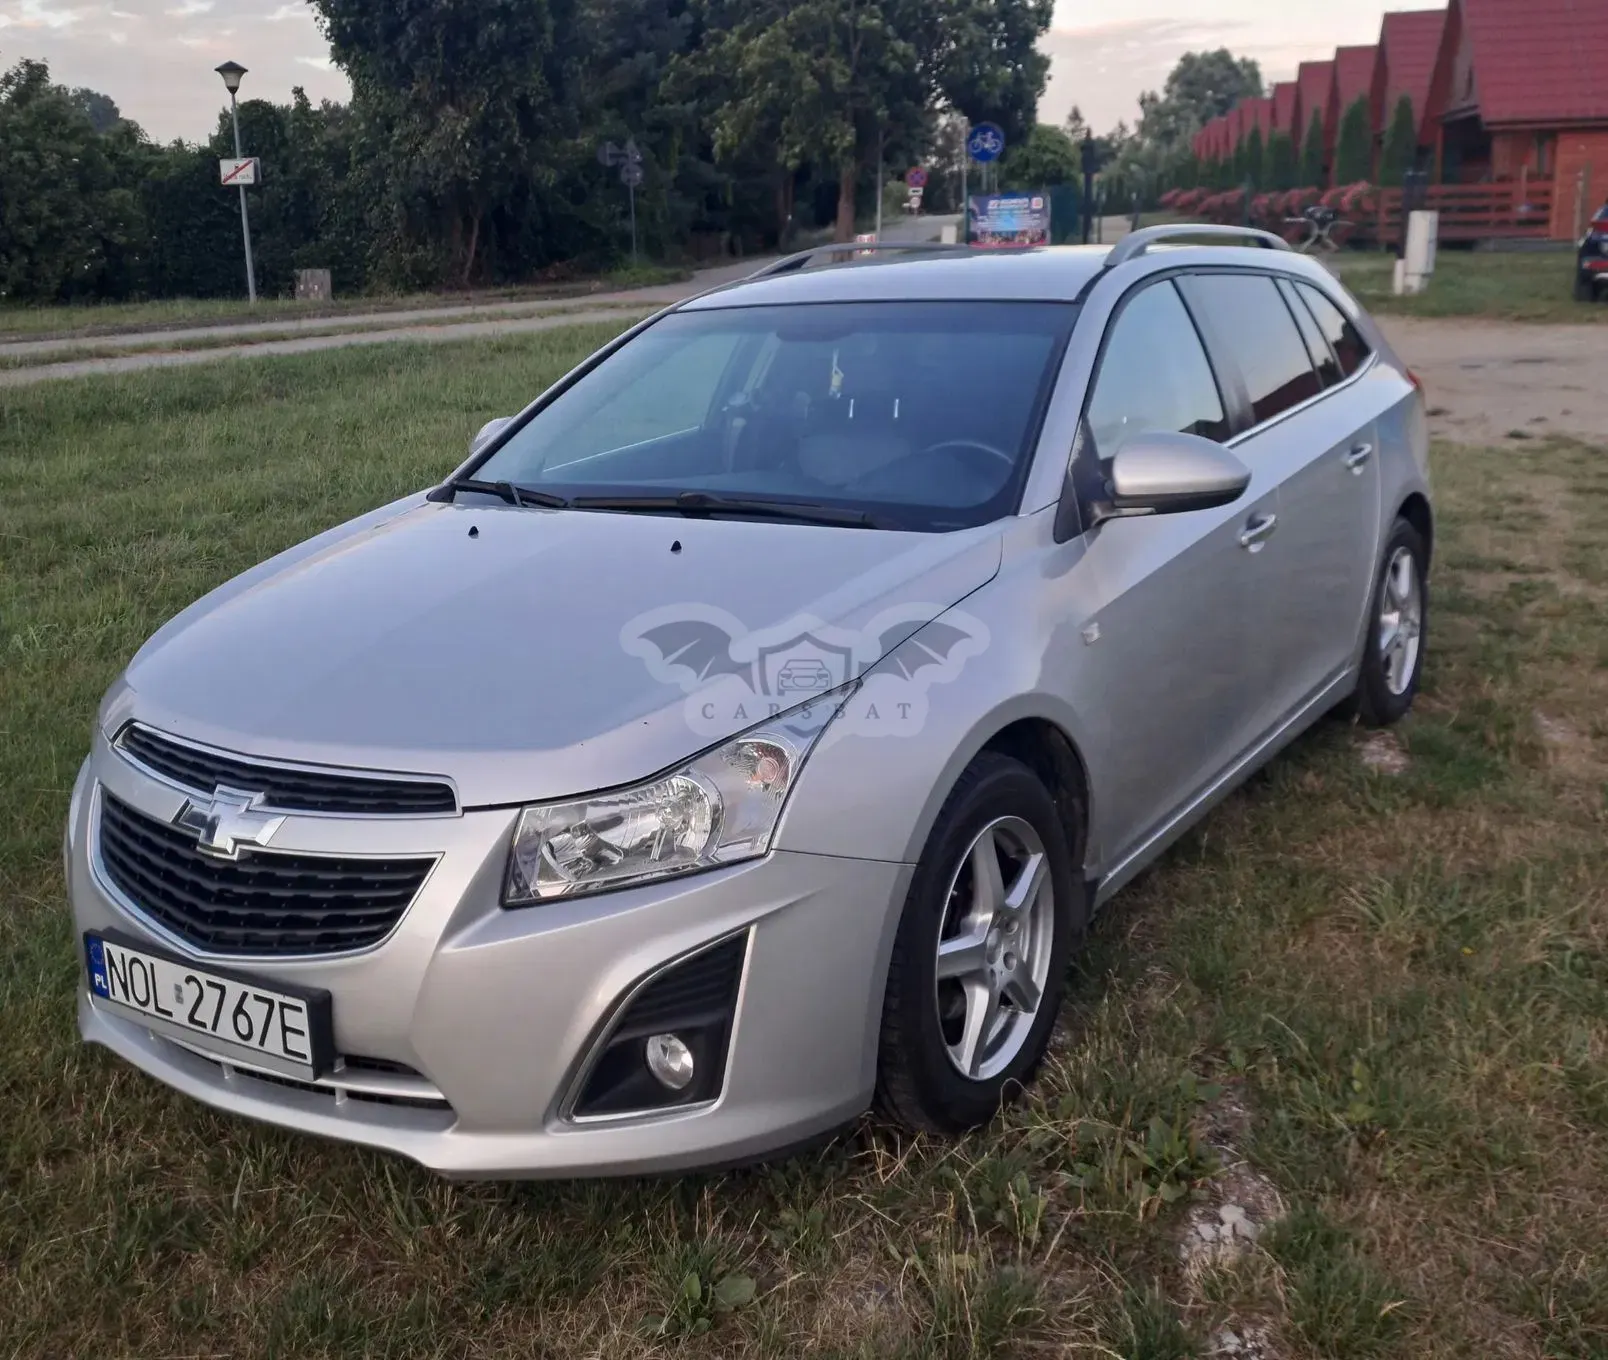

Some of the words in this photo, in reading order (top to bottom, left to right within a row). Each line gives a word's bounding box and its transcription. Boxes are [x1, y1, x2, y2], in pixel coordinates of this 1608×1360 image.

[95, 973, 107, 989] PL
[105, 947, 173, 1018] NOL
[184, 975, 308, 1060] 2767E
